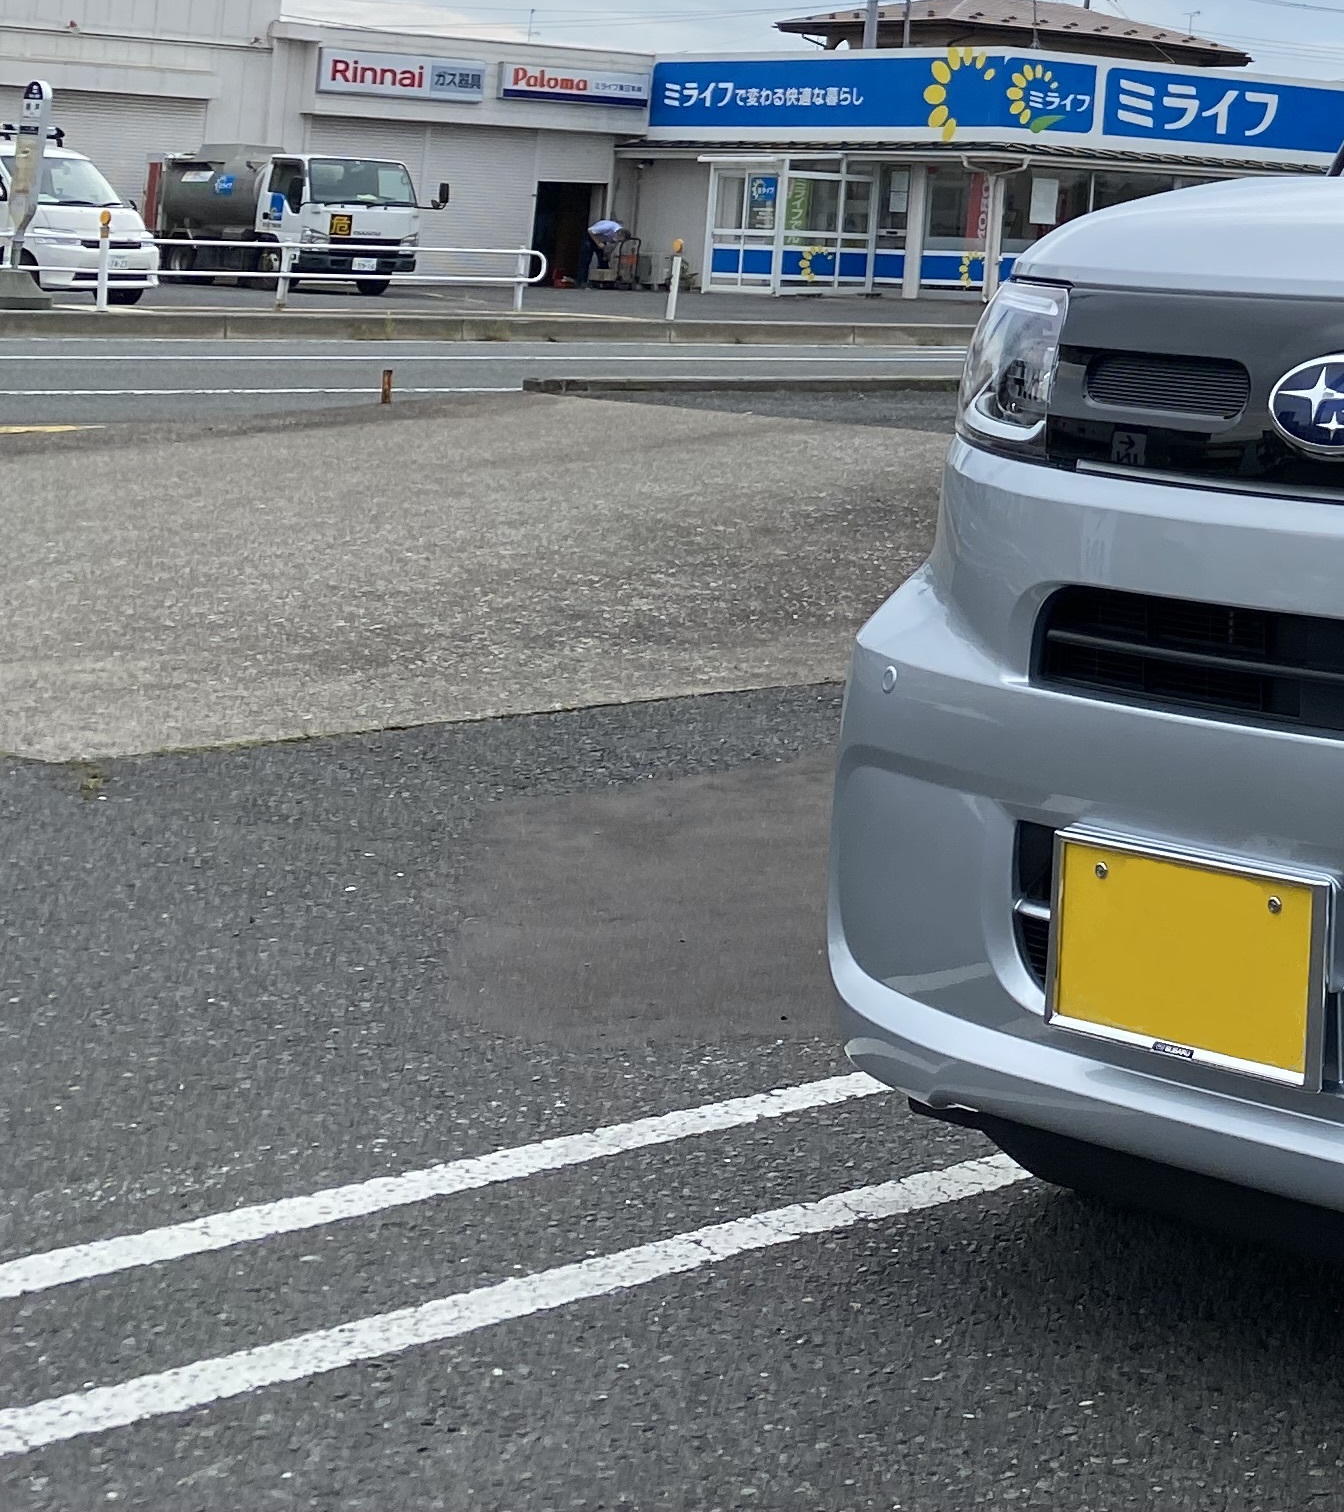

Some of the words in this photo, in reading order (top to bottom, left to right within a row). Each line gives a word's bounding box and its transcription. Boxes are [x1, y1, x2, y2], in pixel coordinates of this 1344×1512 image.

[330, 58, 424, 89] Rinnai
[434, 70, 481, 90] ガス器具
[512, 66, 588, 92] Paloma
[663, 81, 864, 108] ミライフで変わる快適な暮らし
[1028, 90, 1091, 113] ミライフ
[1117, 77, 1279, 137] ミライフ
[331, 215, 351, 236] 危
